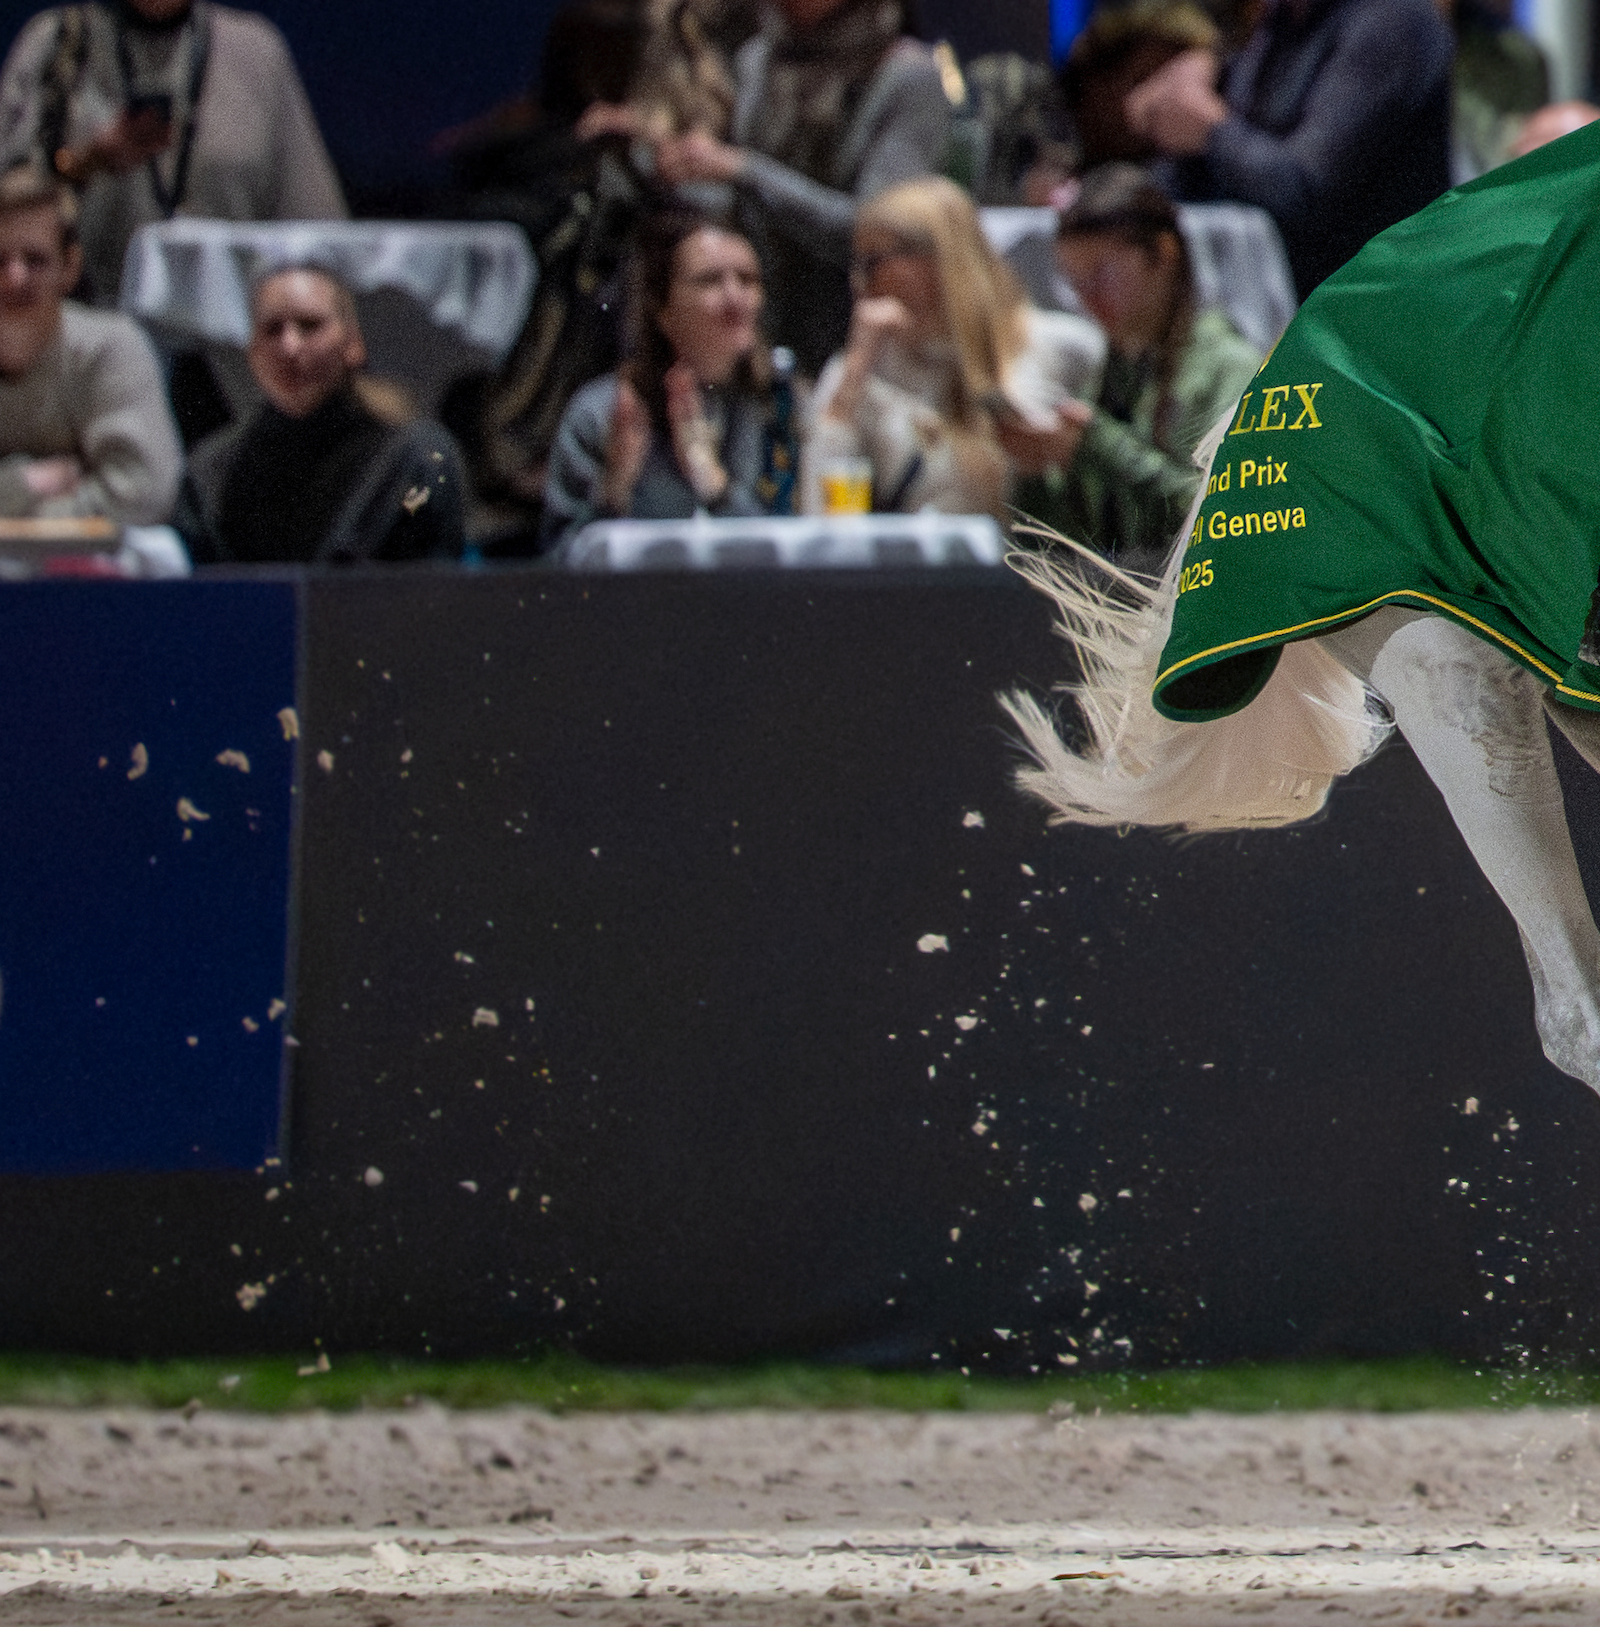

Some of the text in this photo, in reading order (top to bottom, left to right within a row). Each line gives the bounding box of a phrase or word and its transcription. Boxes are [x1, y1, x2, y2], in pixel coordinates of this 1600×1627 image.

[1227, 382, 1323, 438] LEX
[1204, 455, 1288, 498] nd Prix
[1208, 506, 1306, 540] Geneva
[1176, 559, 1214, 599] 025
